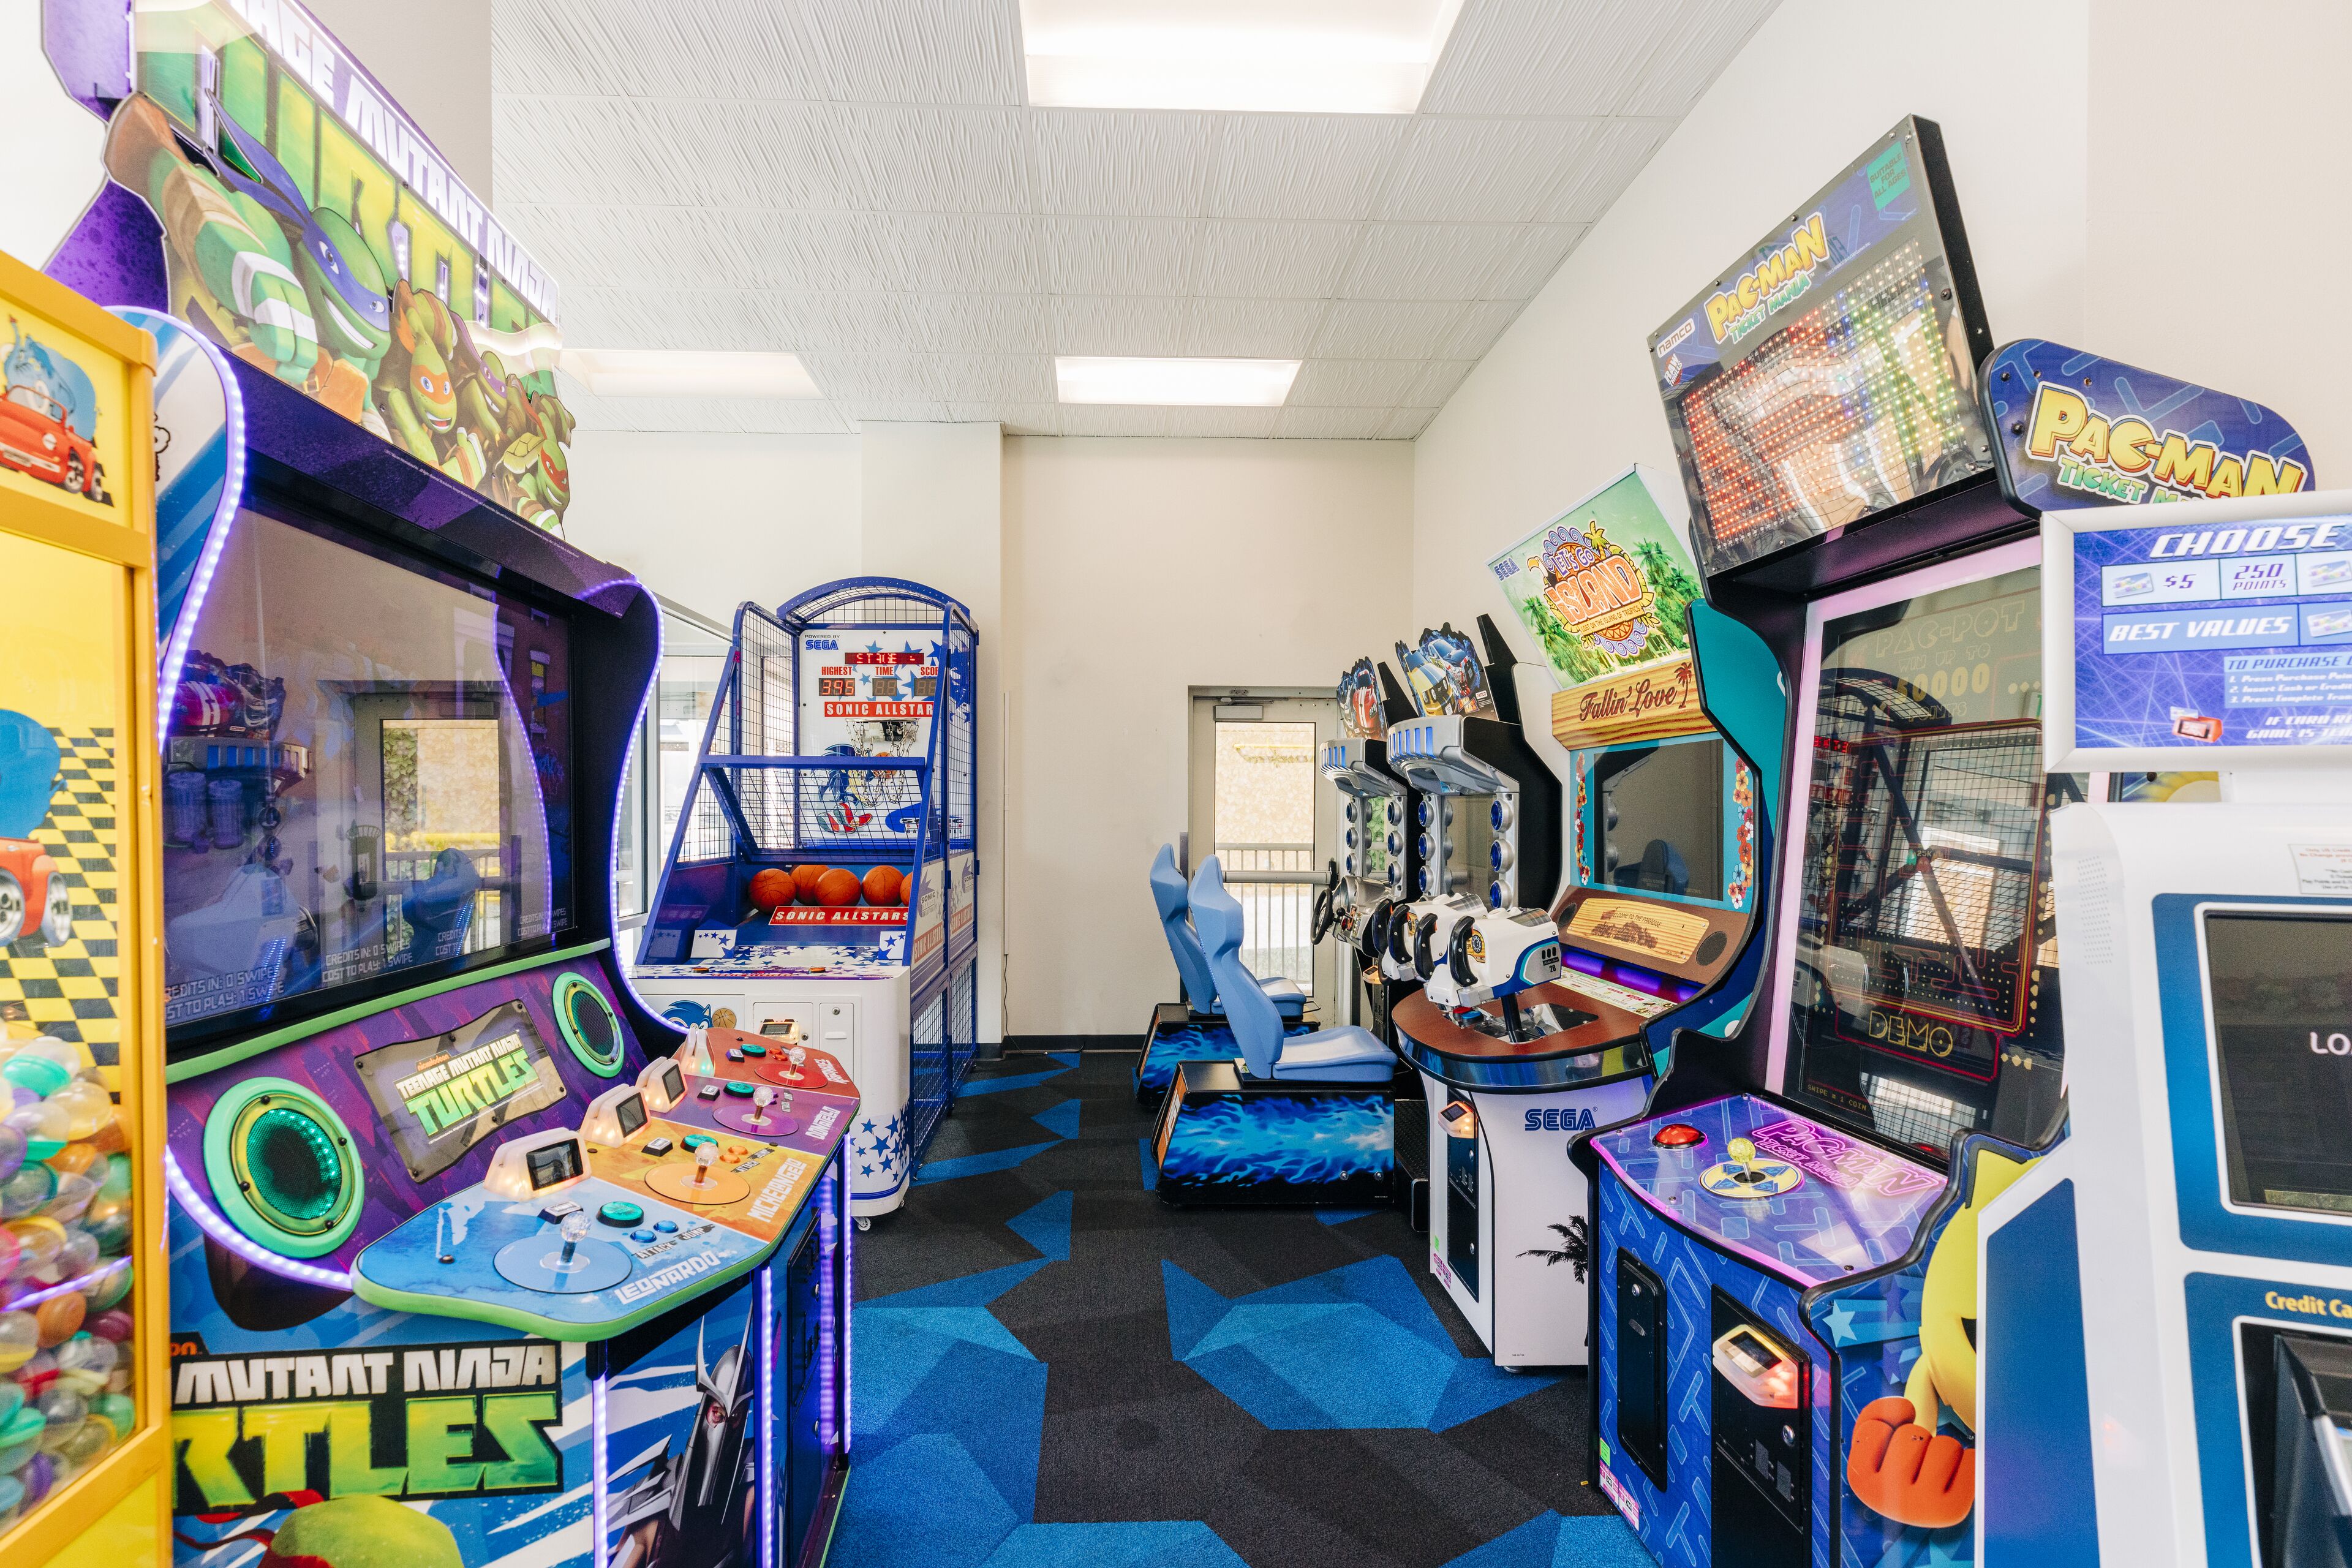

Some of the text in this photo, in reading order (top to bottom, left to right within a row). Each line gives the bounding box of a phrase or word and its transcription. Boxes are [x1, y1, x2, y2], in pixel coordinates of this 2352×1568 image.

[345, 74, 483, 250] MUTANT
[1870, 153, 1902, 183] SUITABLE
[1874, 168, 1906, 198] ALL AGES
[1882, 168, 1894, 183] FOR
[1705, 213, 1828, 341] PAC-MAN
[1730, 274, 1811, 343] TICKET MANIA
[1659, 322, 1694, 355] namco
[2030, 385, 2304, 498] PAC-MAN
[2060, 458, 2146, 502] TICKET
[2149, 522, 2346, 559] CHOOSE
[1494, 558, 1520, 581] SEGA
[1550, 547, 1595, 576] LET'S GO
[2234, 564, 2284, 580] 250
[2164, 573, 2197, 590] $5
[2233, 579, 2286, 591] POINTS
[1580, 624, 1591, 632] LOST
[1616, 612, 1624, 621] OF
[1622, 605, 1641, 619] TROPICS
[2109, 616, 2293, 643] BEST VALUES
[805, 639, 839, 650] SEGA
[1966, 643, 1991, 660] TO
[821, 666, 853, 676] HIGHEST
[875, 666, 894, 676] TIME
[2228, 660, 2248, 670] TO
[2252, 655, 2343, 669] PURCHASE
[822, 680, 855, 696] 395
[1579, 679, 1678, 722] Fallin' Love
[827, 704, 869, 715] SONIC
[2265, 716, 2283, 726] IF
[2285, 715, 2330, 725] CARD
[2245, 729, 2296, 739] GAME
[921, 892, 935, 904] SONIC
[775, 911, 908, 921] SONIC ALLSTARS
[322, 967, 344, 984] COST
[346, 965, 357, 978] TO
[388, 952, 413, 967] SWIPE
[326, 949, 360, 966] CREDITS
[1549, 964, 1556, 973] 28
[186, 1001, 202, 1017] TO
[1868, 1011, 1953, 1057] DEMO
[396, 1033, 522, 1099] TEENAGE MUTANT NINJA
[405, 1048, 538, 1136] TURTLES
[1807, 1084, 1828, 1097] SWIPE
[1849, 1100, 1867, 1111] COIN
[1525, 1108, 1597, 1131] SEGA
[1752, 1120, 1939, 1195] PAC-MAN
[1761, 1139, 1859, 1185] TICKET MANIA
[682, 1227, 704, 1241] JUMP
[636, 1243, 674, 1260] ATTACK
[614, 1250, 721, 1305] LEONARDO
[2266, 1291, 2326, 1316] Credit
[175, 1345, 556, 1404] MUTANT NINJA
